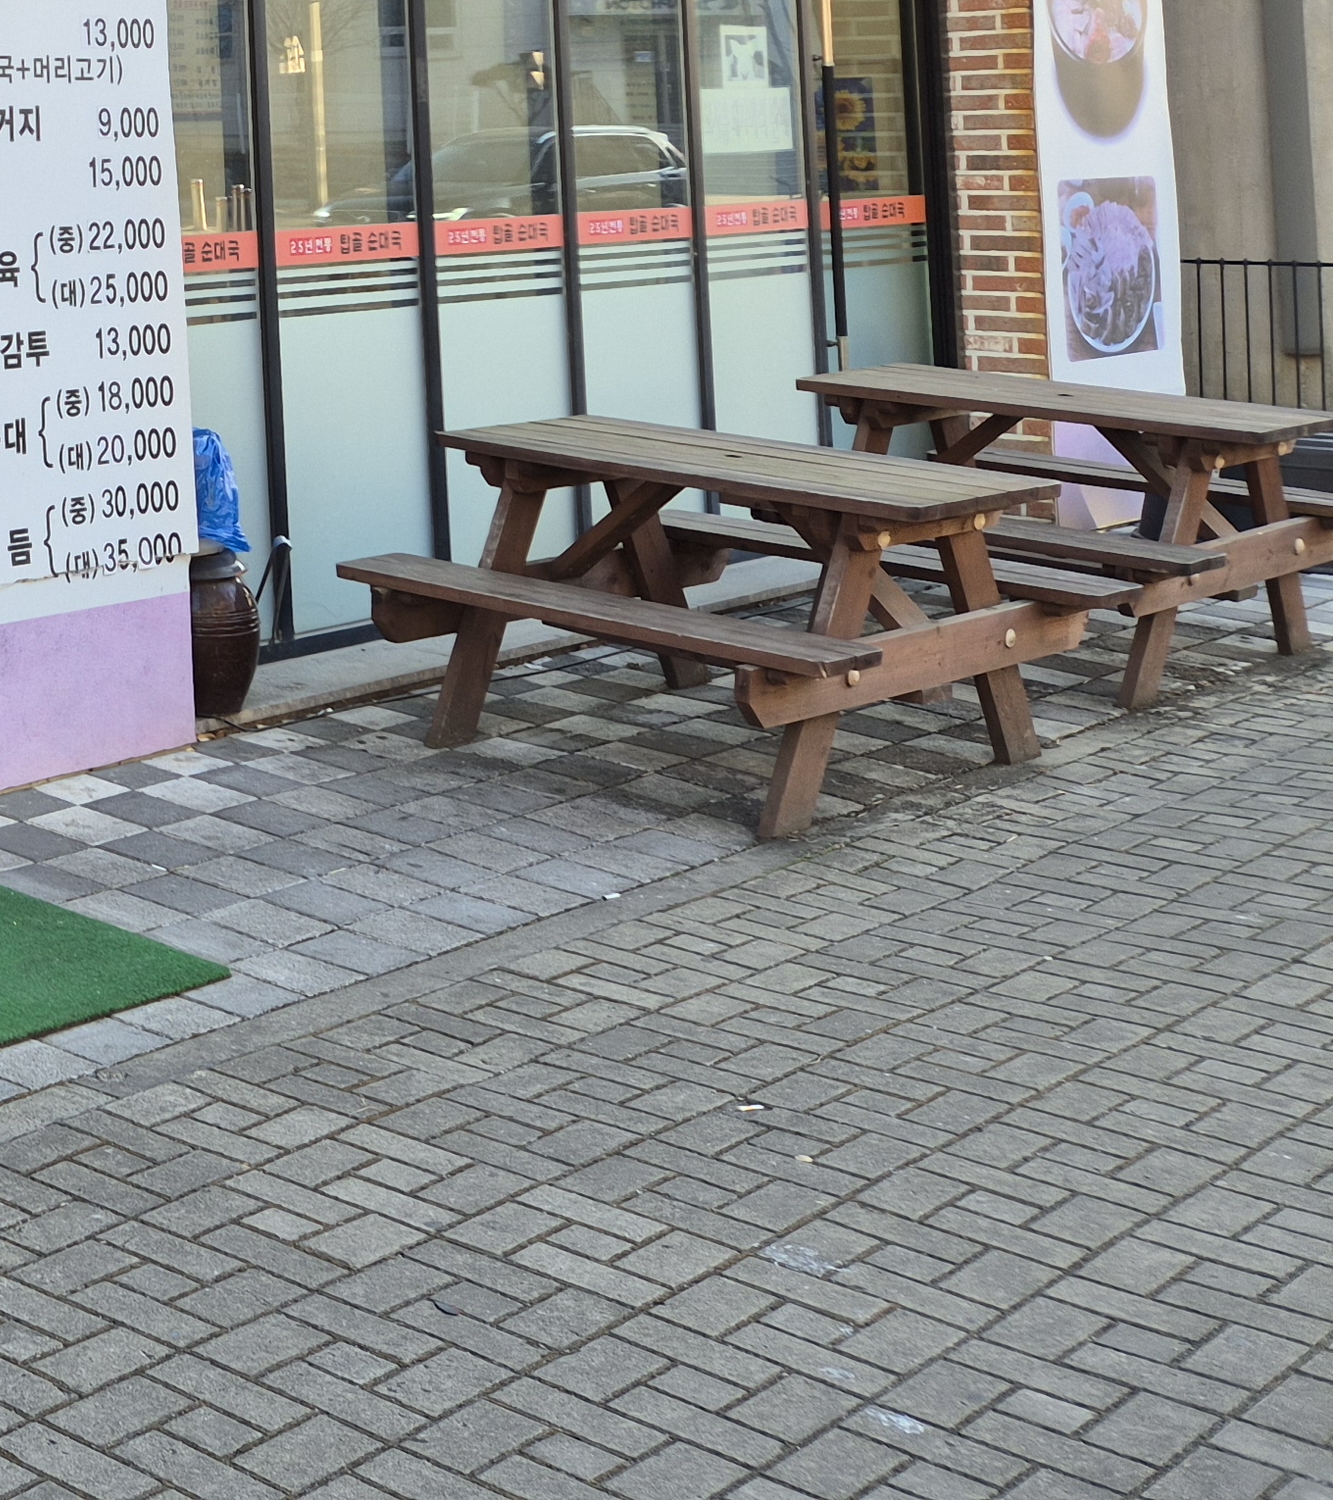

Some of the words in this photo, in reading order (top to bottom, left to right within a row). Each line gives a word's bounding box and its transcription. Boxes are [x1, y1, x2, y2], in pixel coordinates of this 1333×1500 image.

[83, 18, 155, 52] 13,000
[98, 107, 159, 142] 9,000
[89, 155, 162, 189] 15,000
[367, 230, 402, 252] 순대국
[518, 221, 549, 242] 순대국
[201, 240, 240, 264] 순대국
[95, 323, 171, 360] 13,000
[98, 375, 174, 414] 18,000
[101, 480, 179, 518] 30,000
